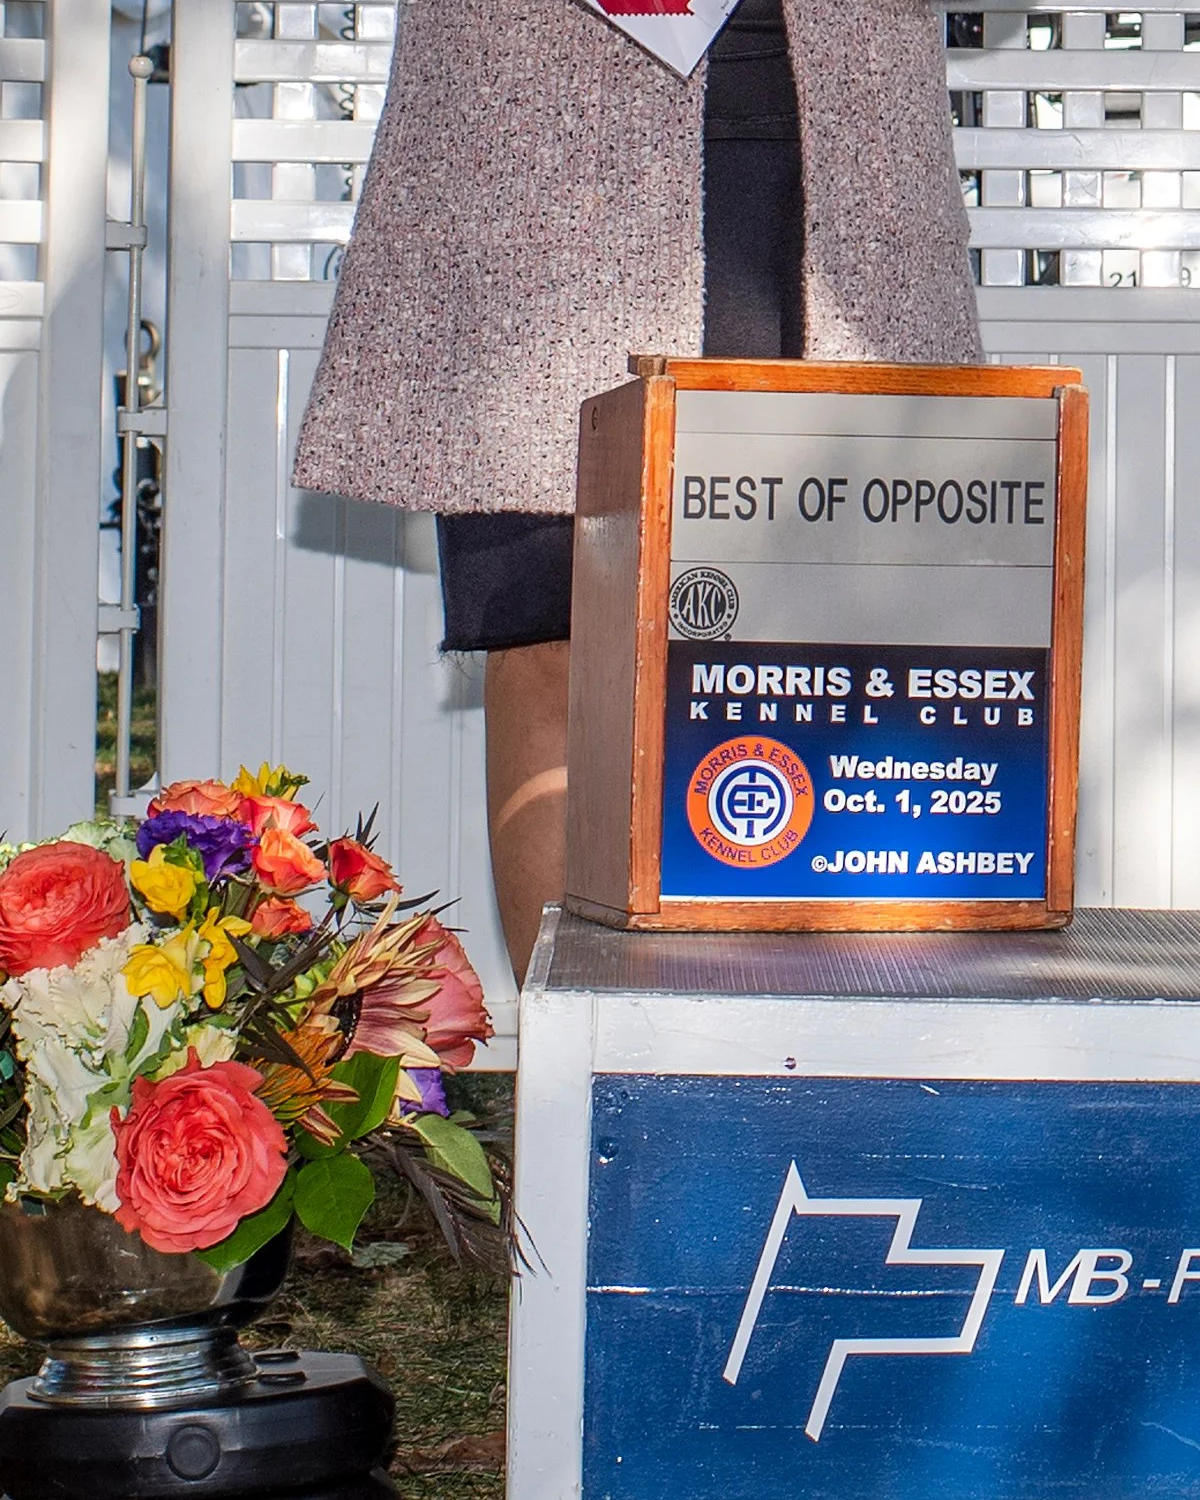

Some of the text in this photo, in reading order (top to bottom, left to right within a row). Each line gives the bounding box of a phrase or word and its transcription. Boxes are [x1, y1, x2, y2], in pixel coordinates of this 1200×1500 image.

[683, 475, 1045, 524] BEST OF OPPOSITE
[671, 571, 698, 610] AMERICAN
[681, 581, 723, 628] AKC
[677, 621, 728, 638] INCORPORATED
[691, 664, 1035, 700] MORRIS & ESSEX
[689, 701, 1035, 726] KENNEL CLUB
[694, 743, 809, 798] MORRIS & ESSEX
[829, 755, 999, 786] Wednesday
[823, 788, 1002, 818] Oct. 1, 2025
[699, 827, 799, 863] KENNEL CLUB
[916, 852, 1035, 875] ASHBEY
